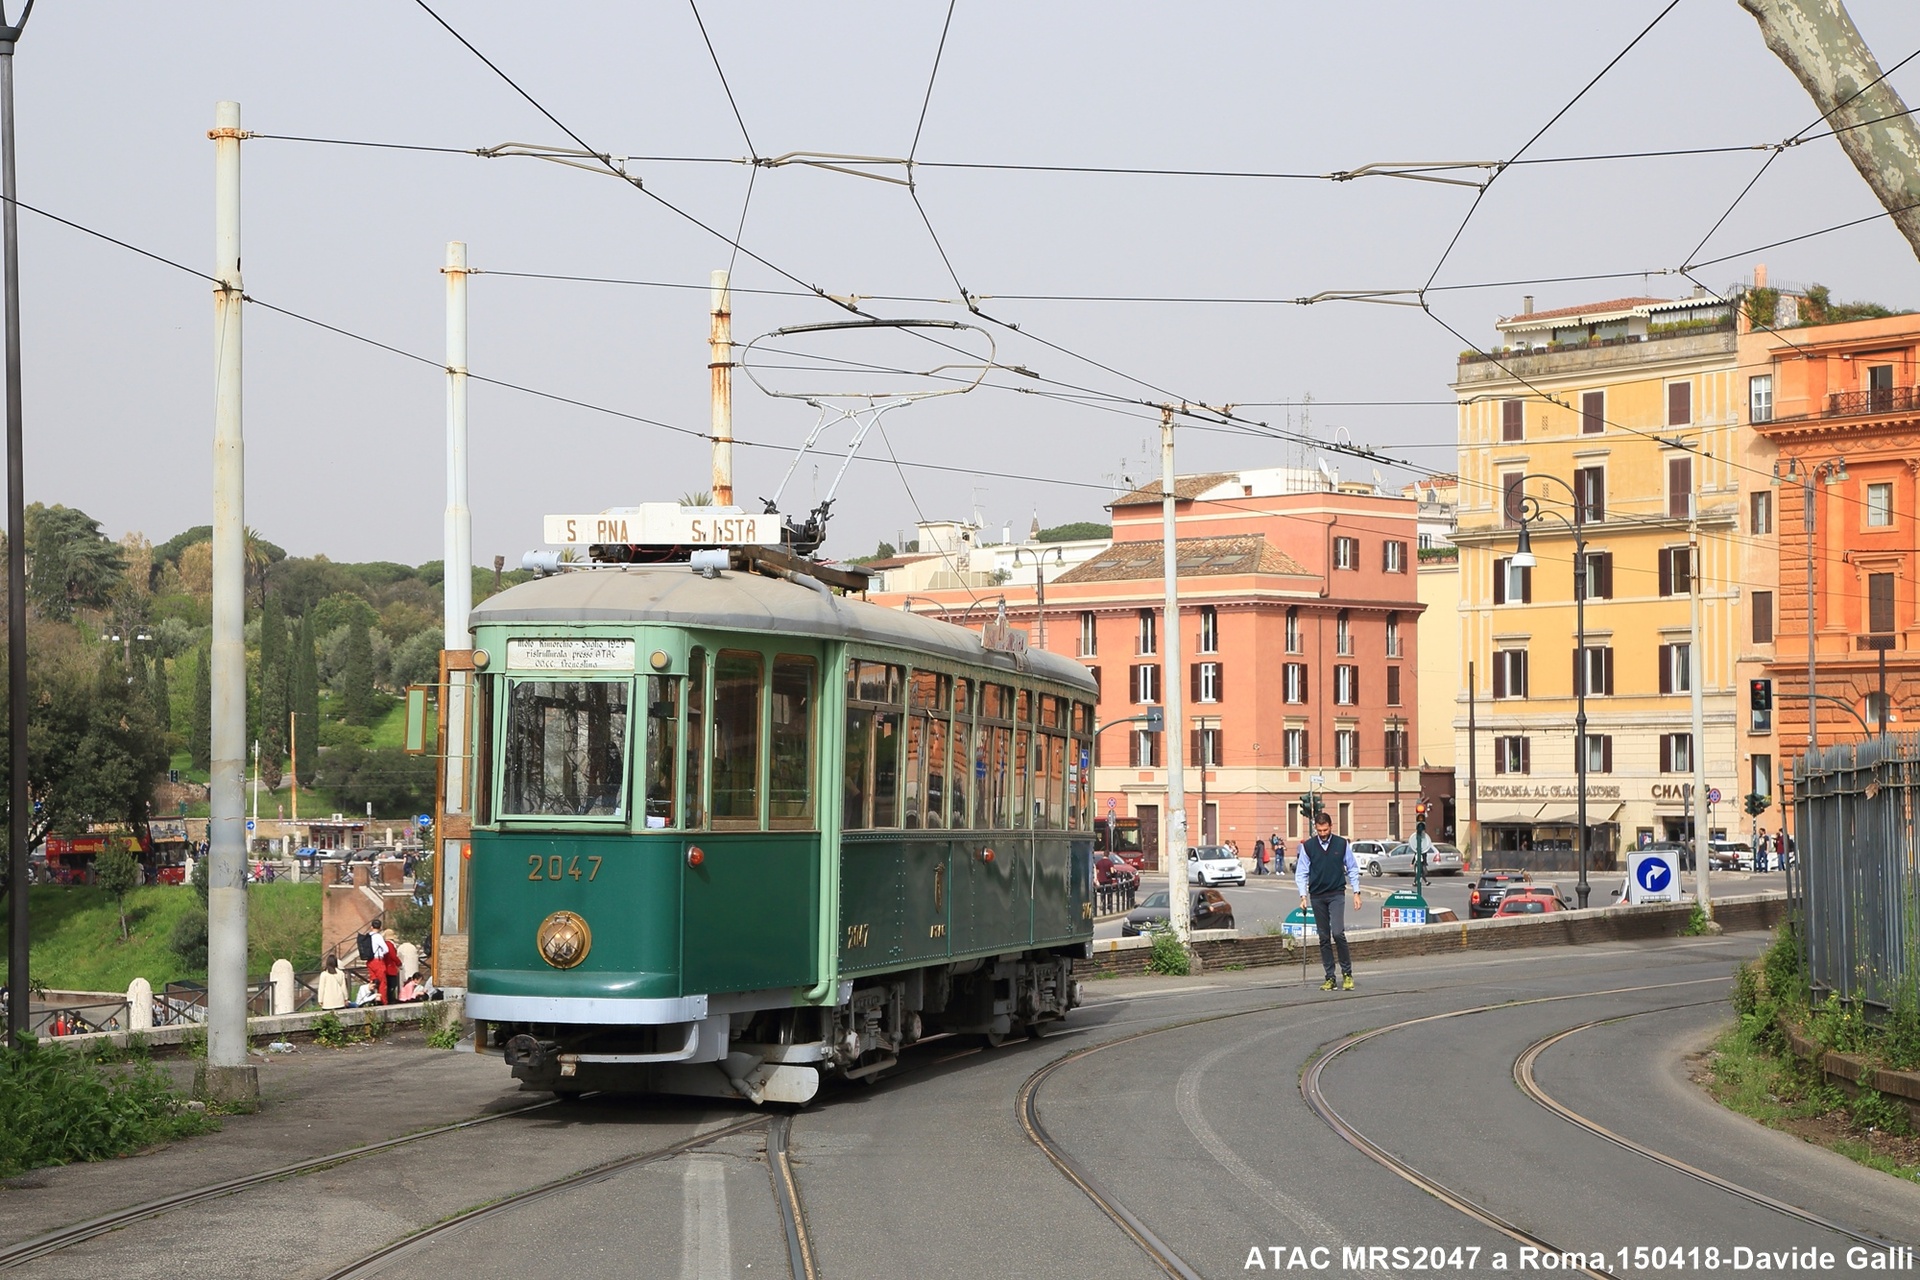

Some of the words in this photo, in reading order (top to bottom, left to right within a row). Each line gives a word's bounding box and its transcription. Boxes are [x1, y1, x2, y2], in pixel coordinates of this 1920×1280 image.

[607, 639, 626, 649] 1929
[595, 650, 615, 659] ATAC
[1533, 785, 1548, 798] AL
[528, 855, 604, 881] 2047
[847, 923, 869, 949] 2047
